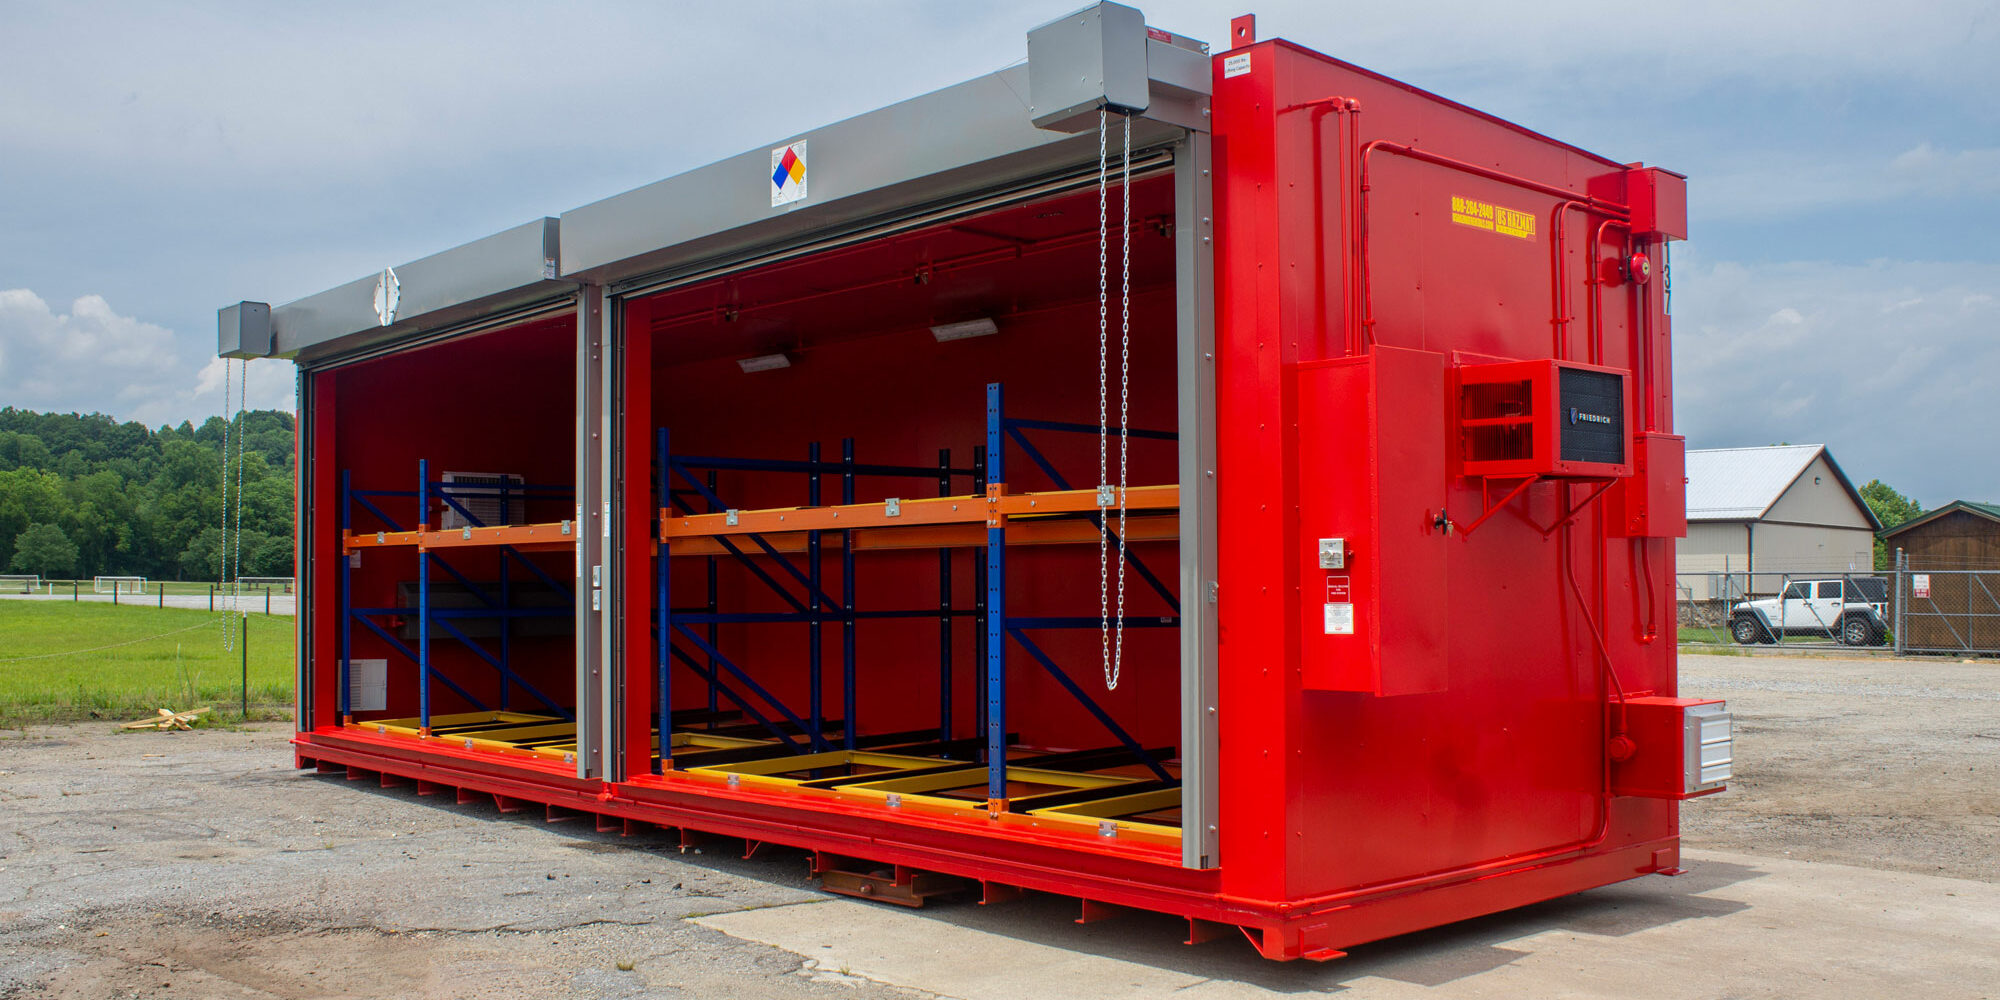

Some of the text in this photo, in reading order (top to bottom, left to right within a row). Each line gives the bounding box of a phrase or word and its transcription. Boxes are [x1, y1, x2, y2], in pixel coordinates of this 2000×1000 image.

[1498, 210, 1506, 226] US
[1507, 211, 1533, 233] HAZMAT
[1579, 412, 1611, 424] FRIEDRICH
